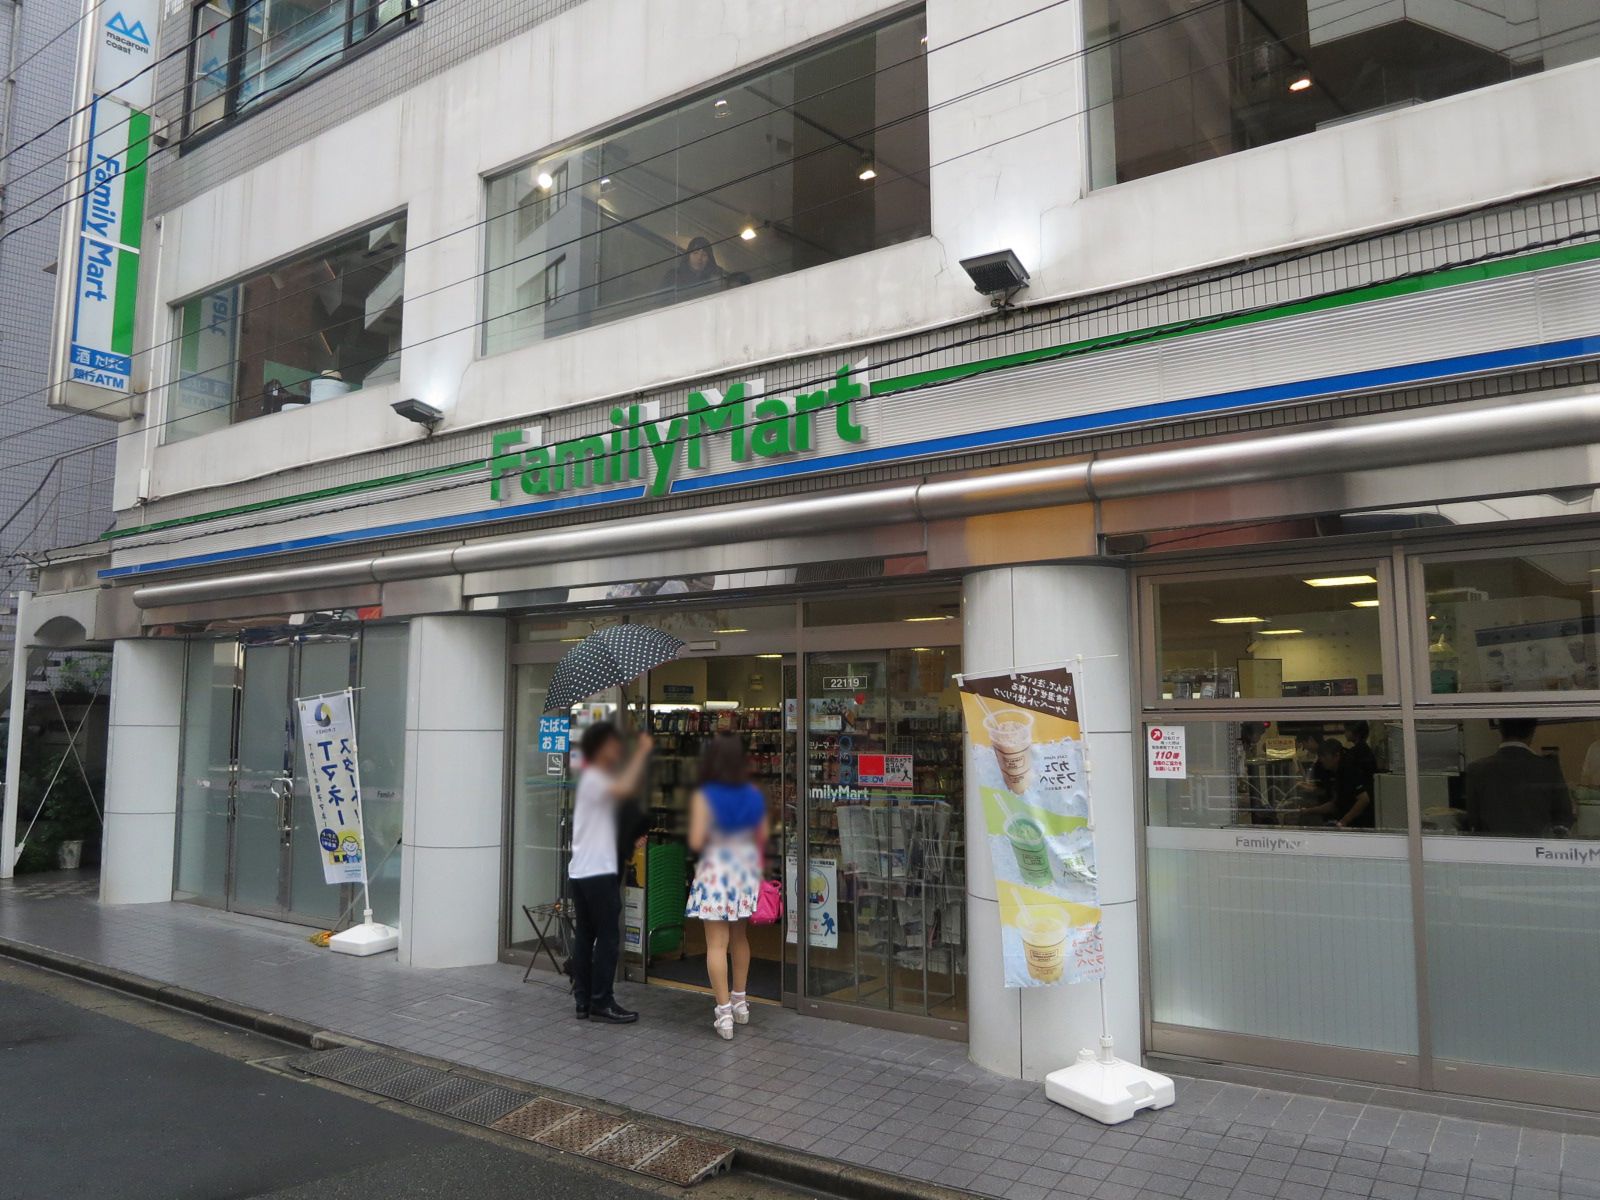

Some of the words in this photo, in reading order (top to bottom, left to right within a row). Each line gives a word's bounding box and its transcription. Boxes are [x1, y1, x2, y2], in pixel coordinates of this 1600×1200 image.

[105, 39, 131, 55] coast
[106, 31, 149, 54] macaroni
[76, 348, 91, 365] 酒
[95, 354, 124, 372] たばこ
[73, 367, 124, 389] 銀行ATM
[489, 361, 866, 500] FamilyMart
[830, 678, 860, 688] 22119
[540, 718, 569, 733] たばこ
